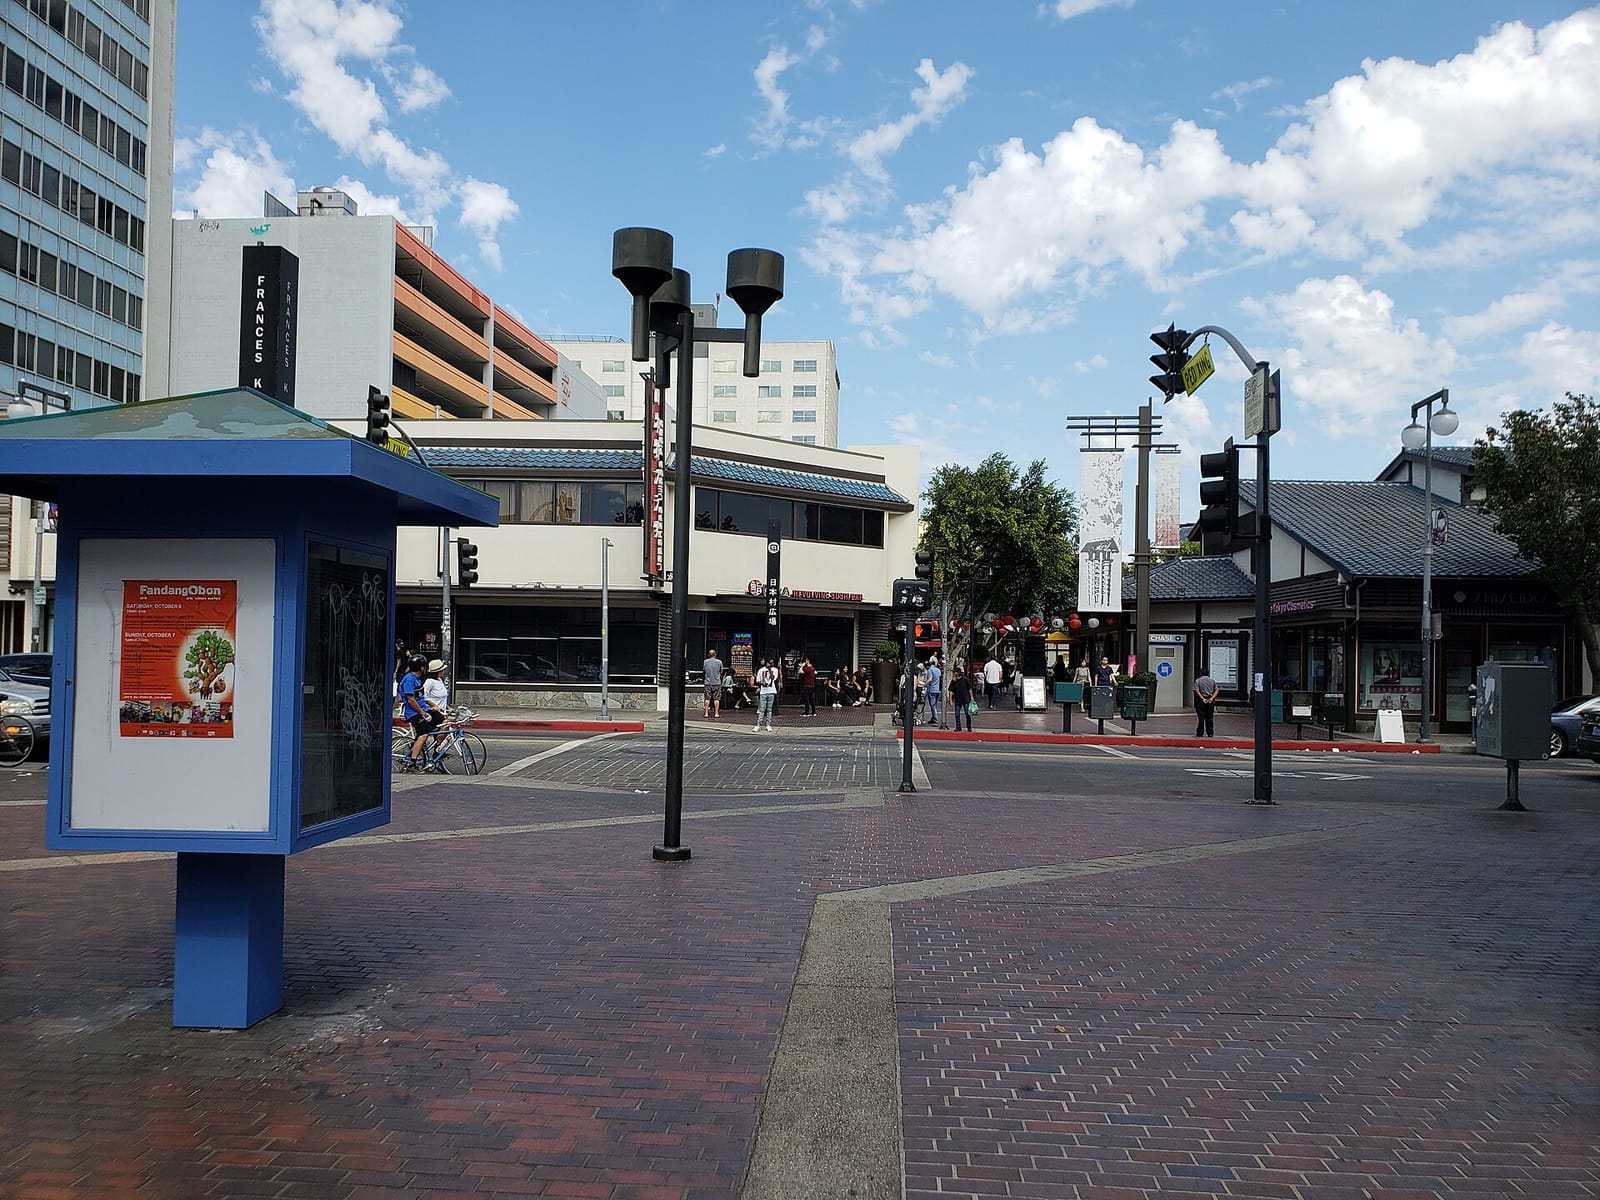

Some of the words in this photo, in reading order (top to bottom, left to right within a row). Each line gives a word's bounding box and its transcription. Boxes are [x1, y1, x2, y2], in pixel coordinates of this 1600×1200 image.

[254, 275, 265, 363] FRANCES
[284, 281, 292, 368] FRANCES
[1185, 366, 1198, 389] PED
[1196, 350, 1211, 378] XING
[254, 378, 262, 388] K
[139, 585, 221, 596] FandangObon
[793, 590, 830, 600] REVOLVING
[831, 592, 850, 601] SUSHI
